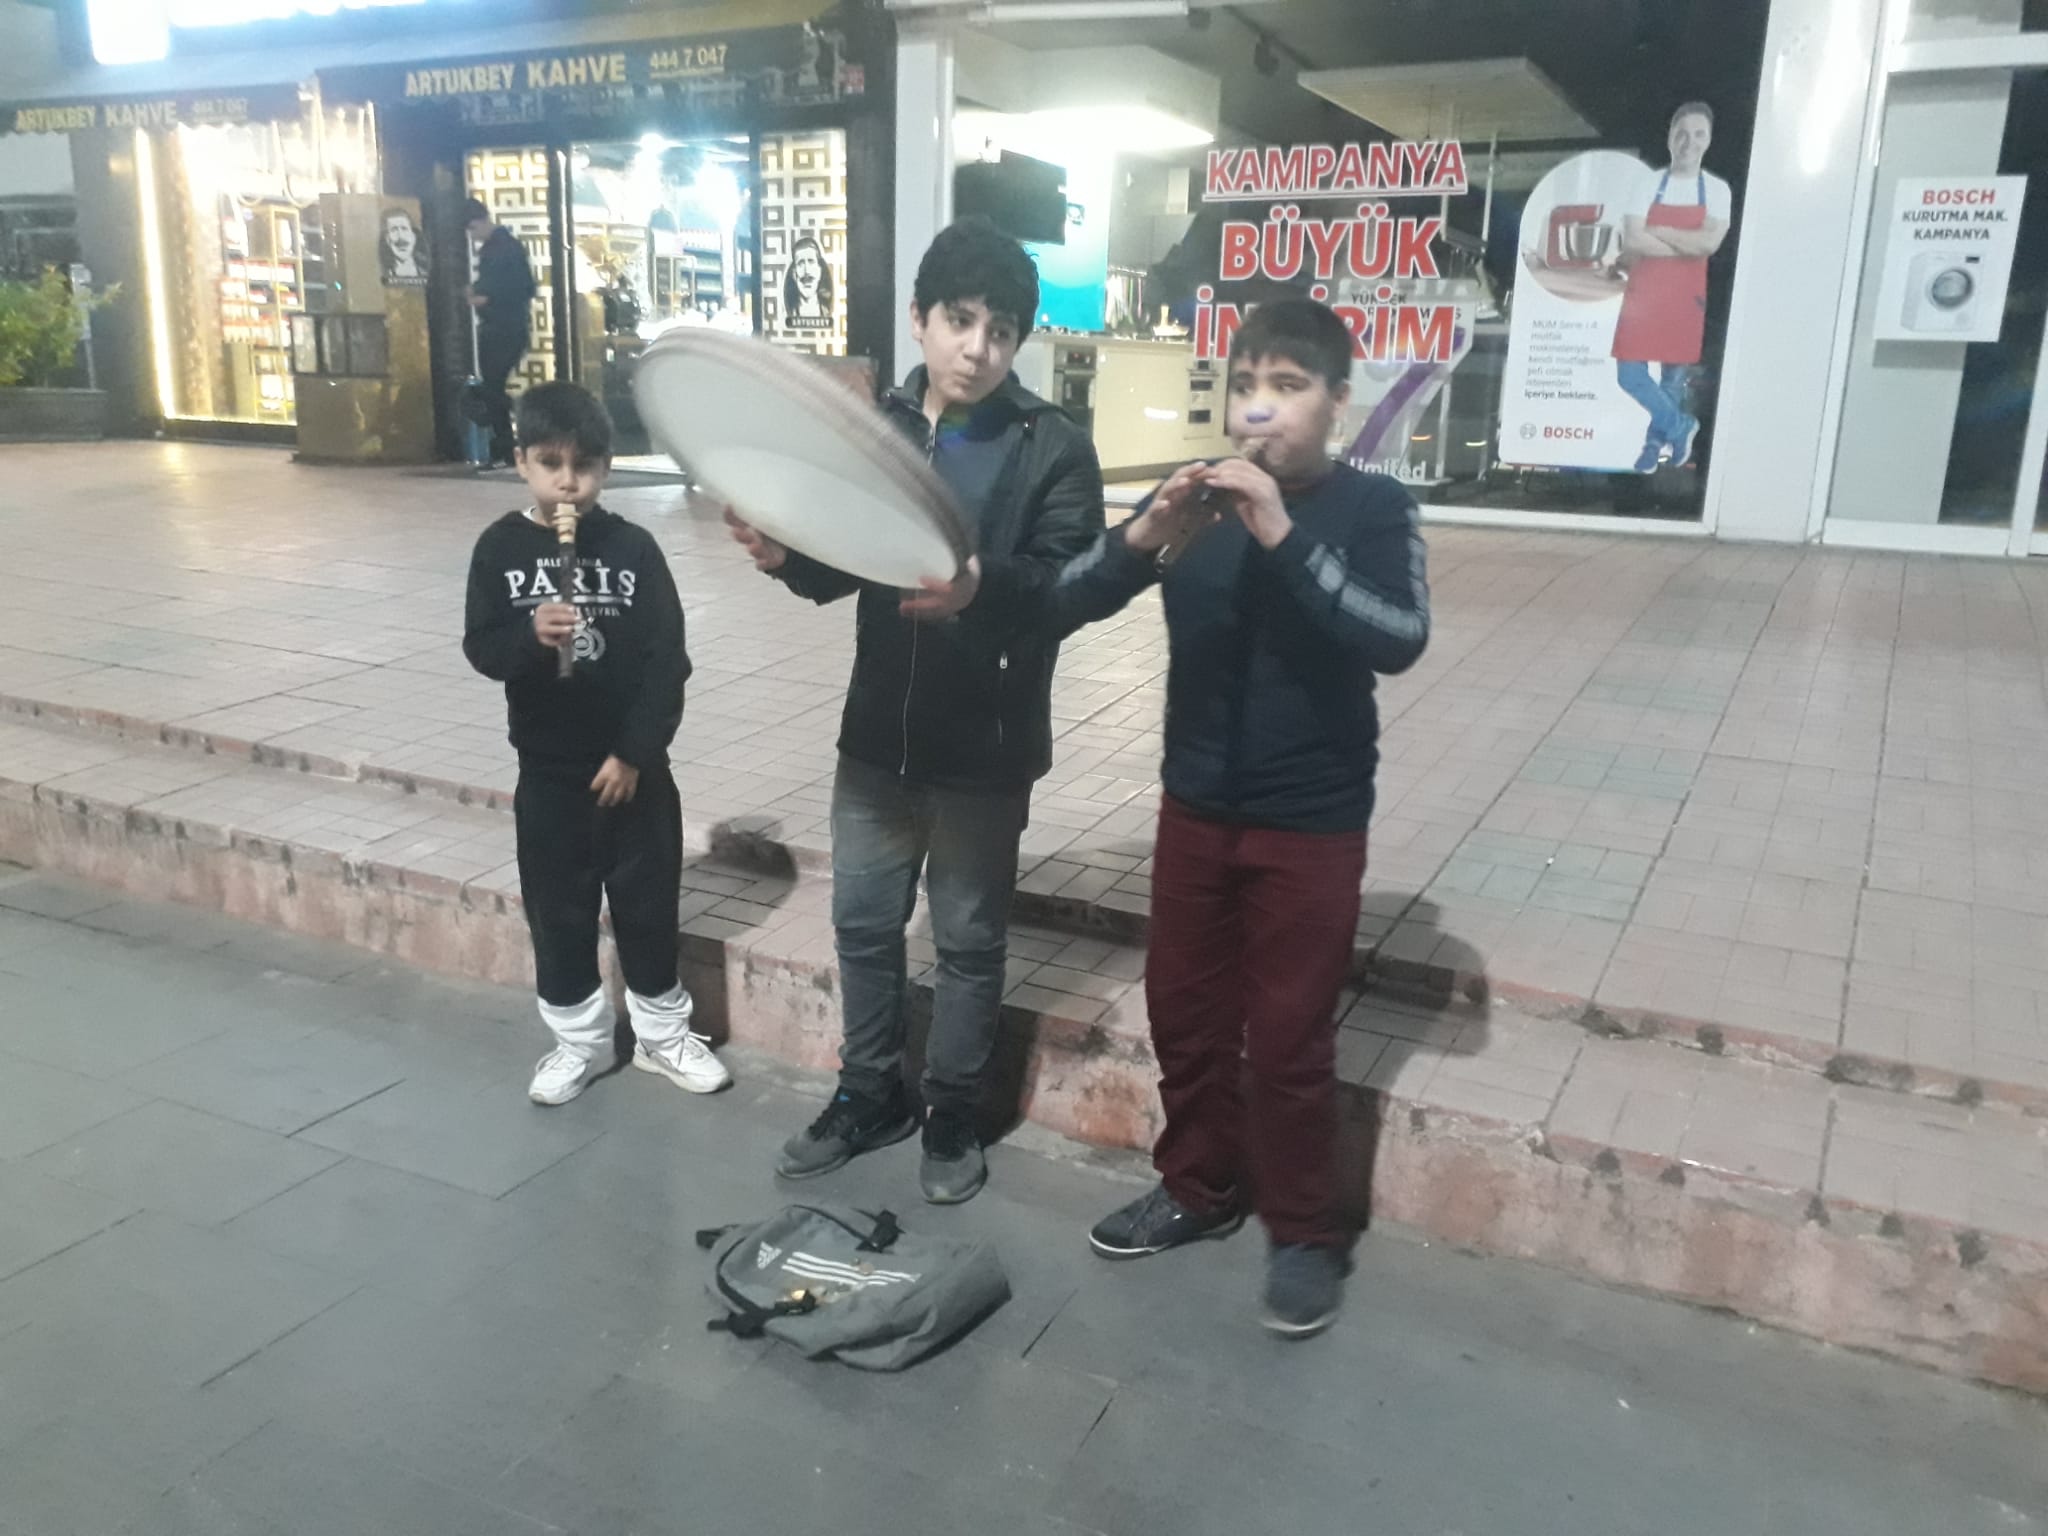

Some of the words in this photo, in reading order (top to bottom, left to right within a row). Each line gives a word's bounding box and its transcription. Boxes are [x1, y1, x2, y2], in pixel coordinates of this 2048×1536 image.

[406, 63, 515, 97] ARTUKBEY
[527, 54, 626, 89] KAHVE
[650, 50, 678, 69] 444
[684, 48, 693, 67] 7
[698, 45, 728, 66] 047
[17, 107, 95, 130] ARTUKBEY
[106, 103, 176, 127] KAHVE
[1206, 140, 1467, 194] KAMPANYA
[1922, 189, 1996, 205] BOSCH
[1902, 210, 1968, 222] KURUTMA
[1973, 210, 2008, 222] MAK.
[1220, 203, 1442, 281] BÜYÜK
[1913, 228, 1990, 240] KAMPANYA
[1351, 290, 1407, 305] YÜKEK
[1193, 285, 1458, 362] İNRİM
[1544, 426, 1594, 440] BOSCH
[504, 567, 636, 599] PARIS
